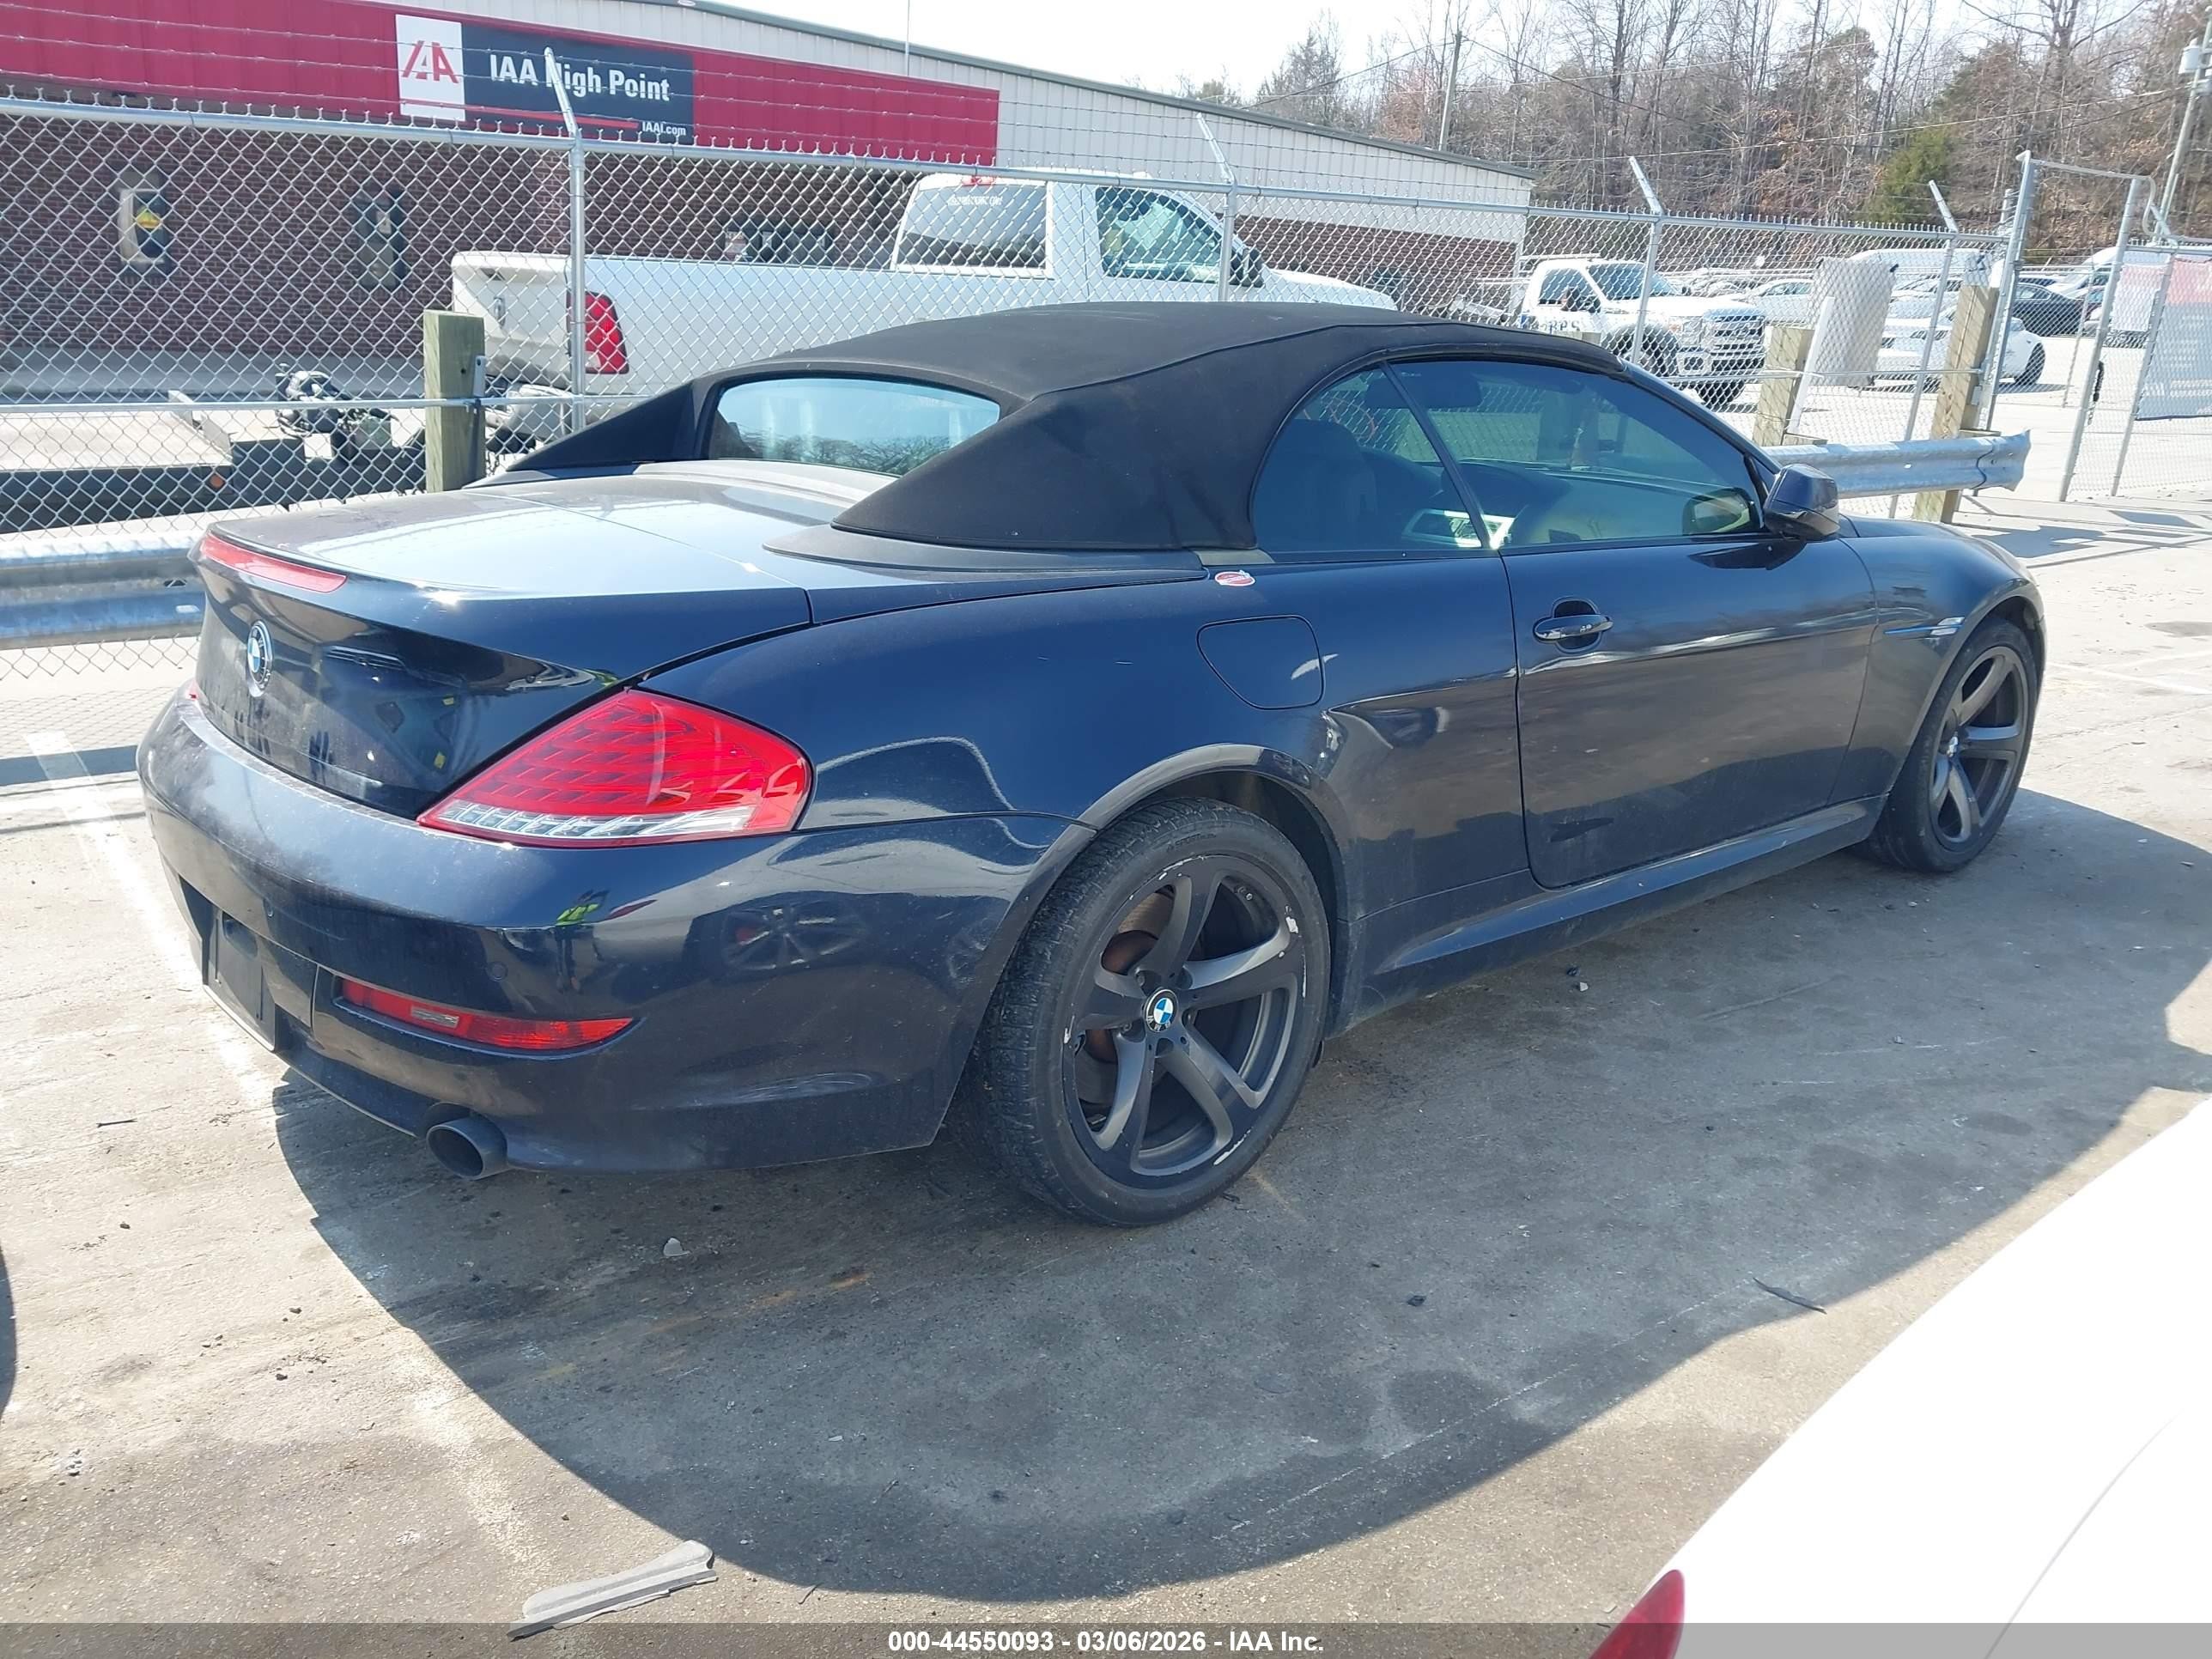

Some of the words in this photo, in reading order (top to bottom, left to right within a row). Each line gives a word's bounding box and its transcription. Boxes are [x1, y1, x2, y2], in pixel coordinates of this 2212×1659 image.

[489, 53, 538, 86] IAA
[608, 70, 670, 102] Point
[641, 121, 687, 136] IAAI.com
